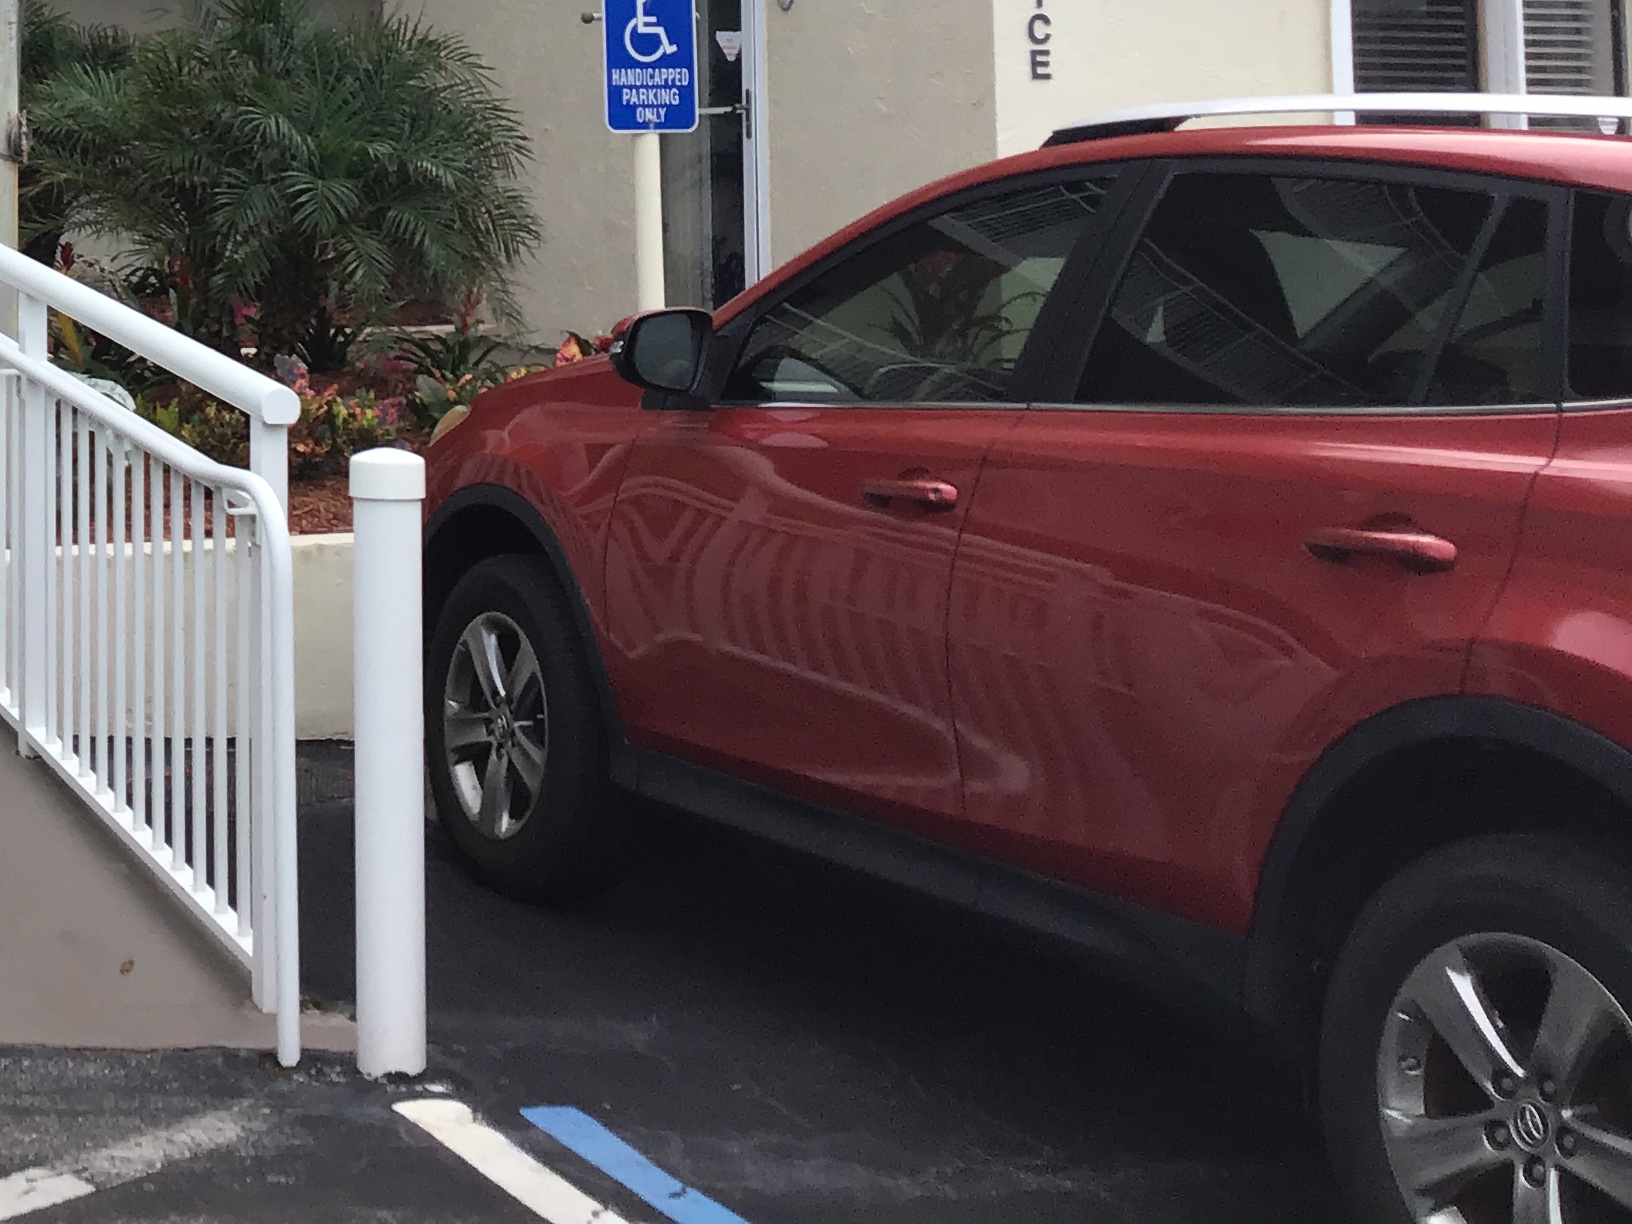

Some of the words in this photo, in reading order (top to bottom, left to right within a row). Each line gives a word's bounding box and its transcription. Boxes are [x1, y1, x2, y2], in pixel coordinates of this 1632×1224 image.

[611, 68, 689, 86] HANDICAPPED
[622, 87, 680, 105] PARKING
[636, 107, 667, 123] ONLY
